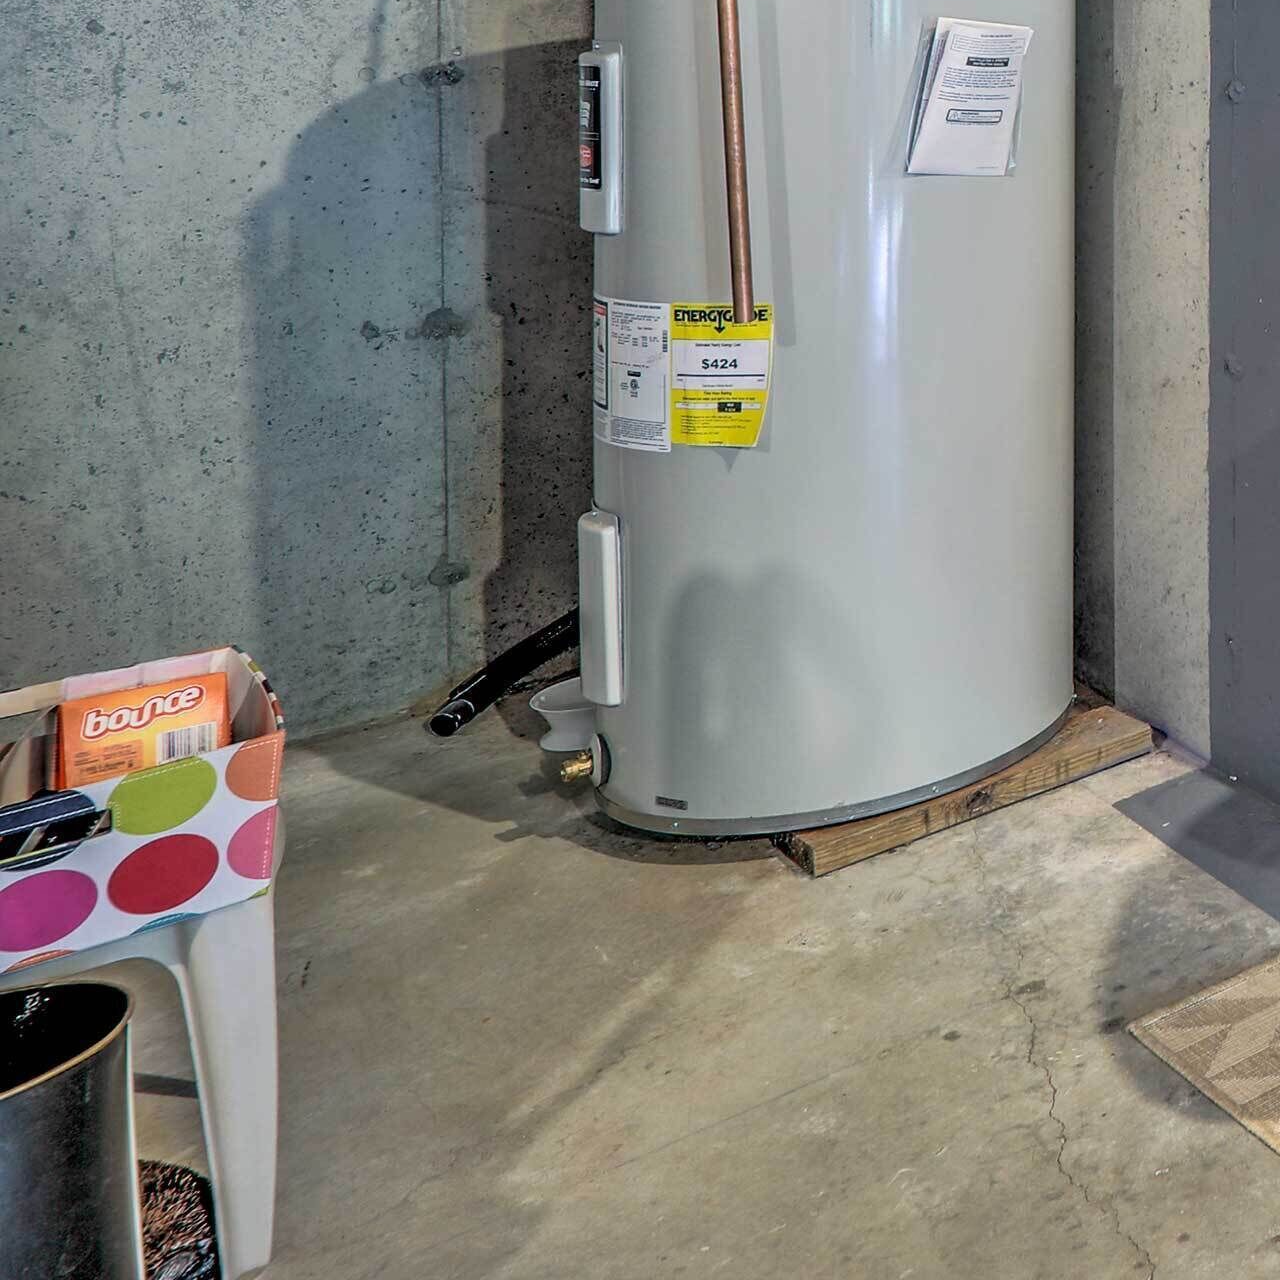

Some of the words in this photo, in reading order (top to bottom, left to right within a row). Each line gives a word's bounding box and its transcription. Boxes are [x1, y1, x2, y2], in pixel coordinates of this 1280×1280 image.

[673, 309, 768, 323] ENERGYGDE
[701, 358, 738, 370] $424
[84, 686, 202, 738] bounce
